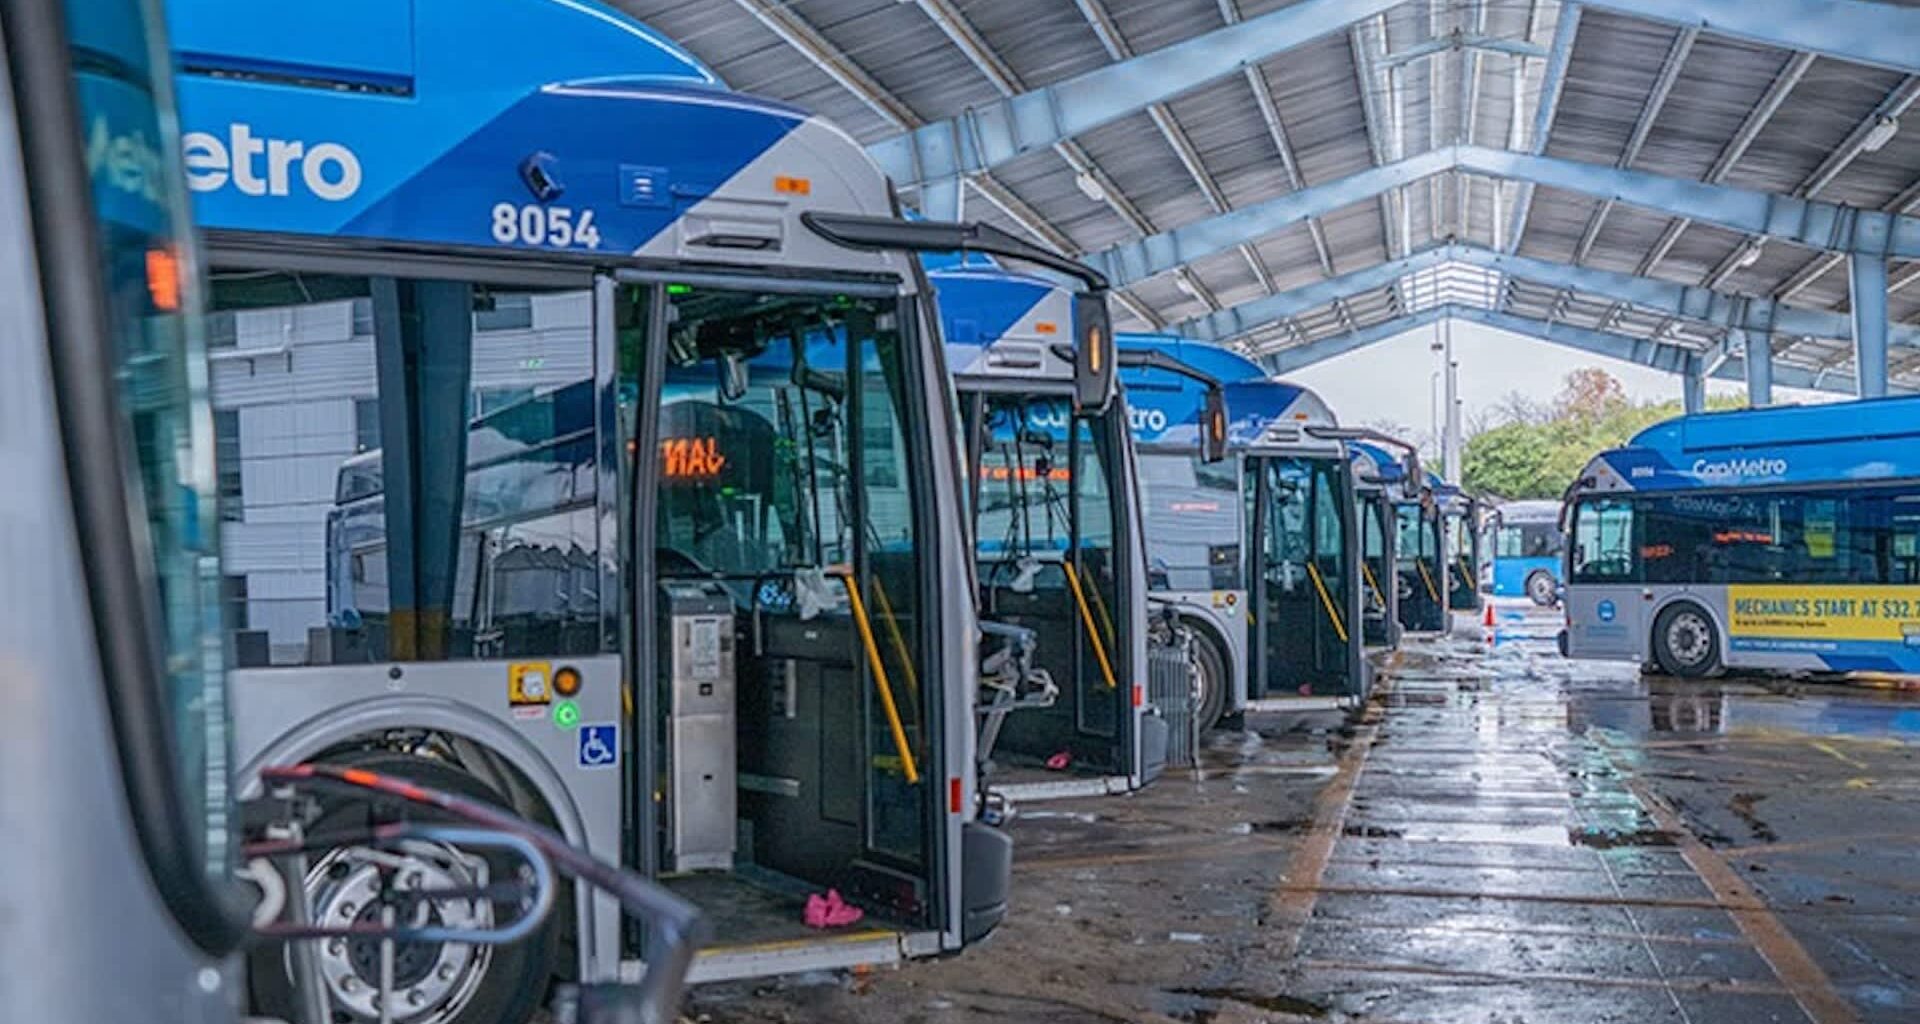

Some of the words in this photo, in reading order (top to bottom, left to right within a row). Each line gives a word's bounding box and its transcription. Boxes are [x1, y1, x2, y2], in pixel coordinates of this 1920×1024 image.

[183, 122, 363, 202] etro
[491, 202, 601, 249] 8054
[1692, 457, 1788, 480] CapMetro
[1734, 598, 1810, 616] MECHANICS
[1814, 598, 1857, 617] START
[1861, 599, 1878, 617] AT
